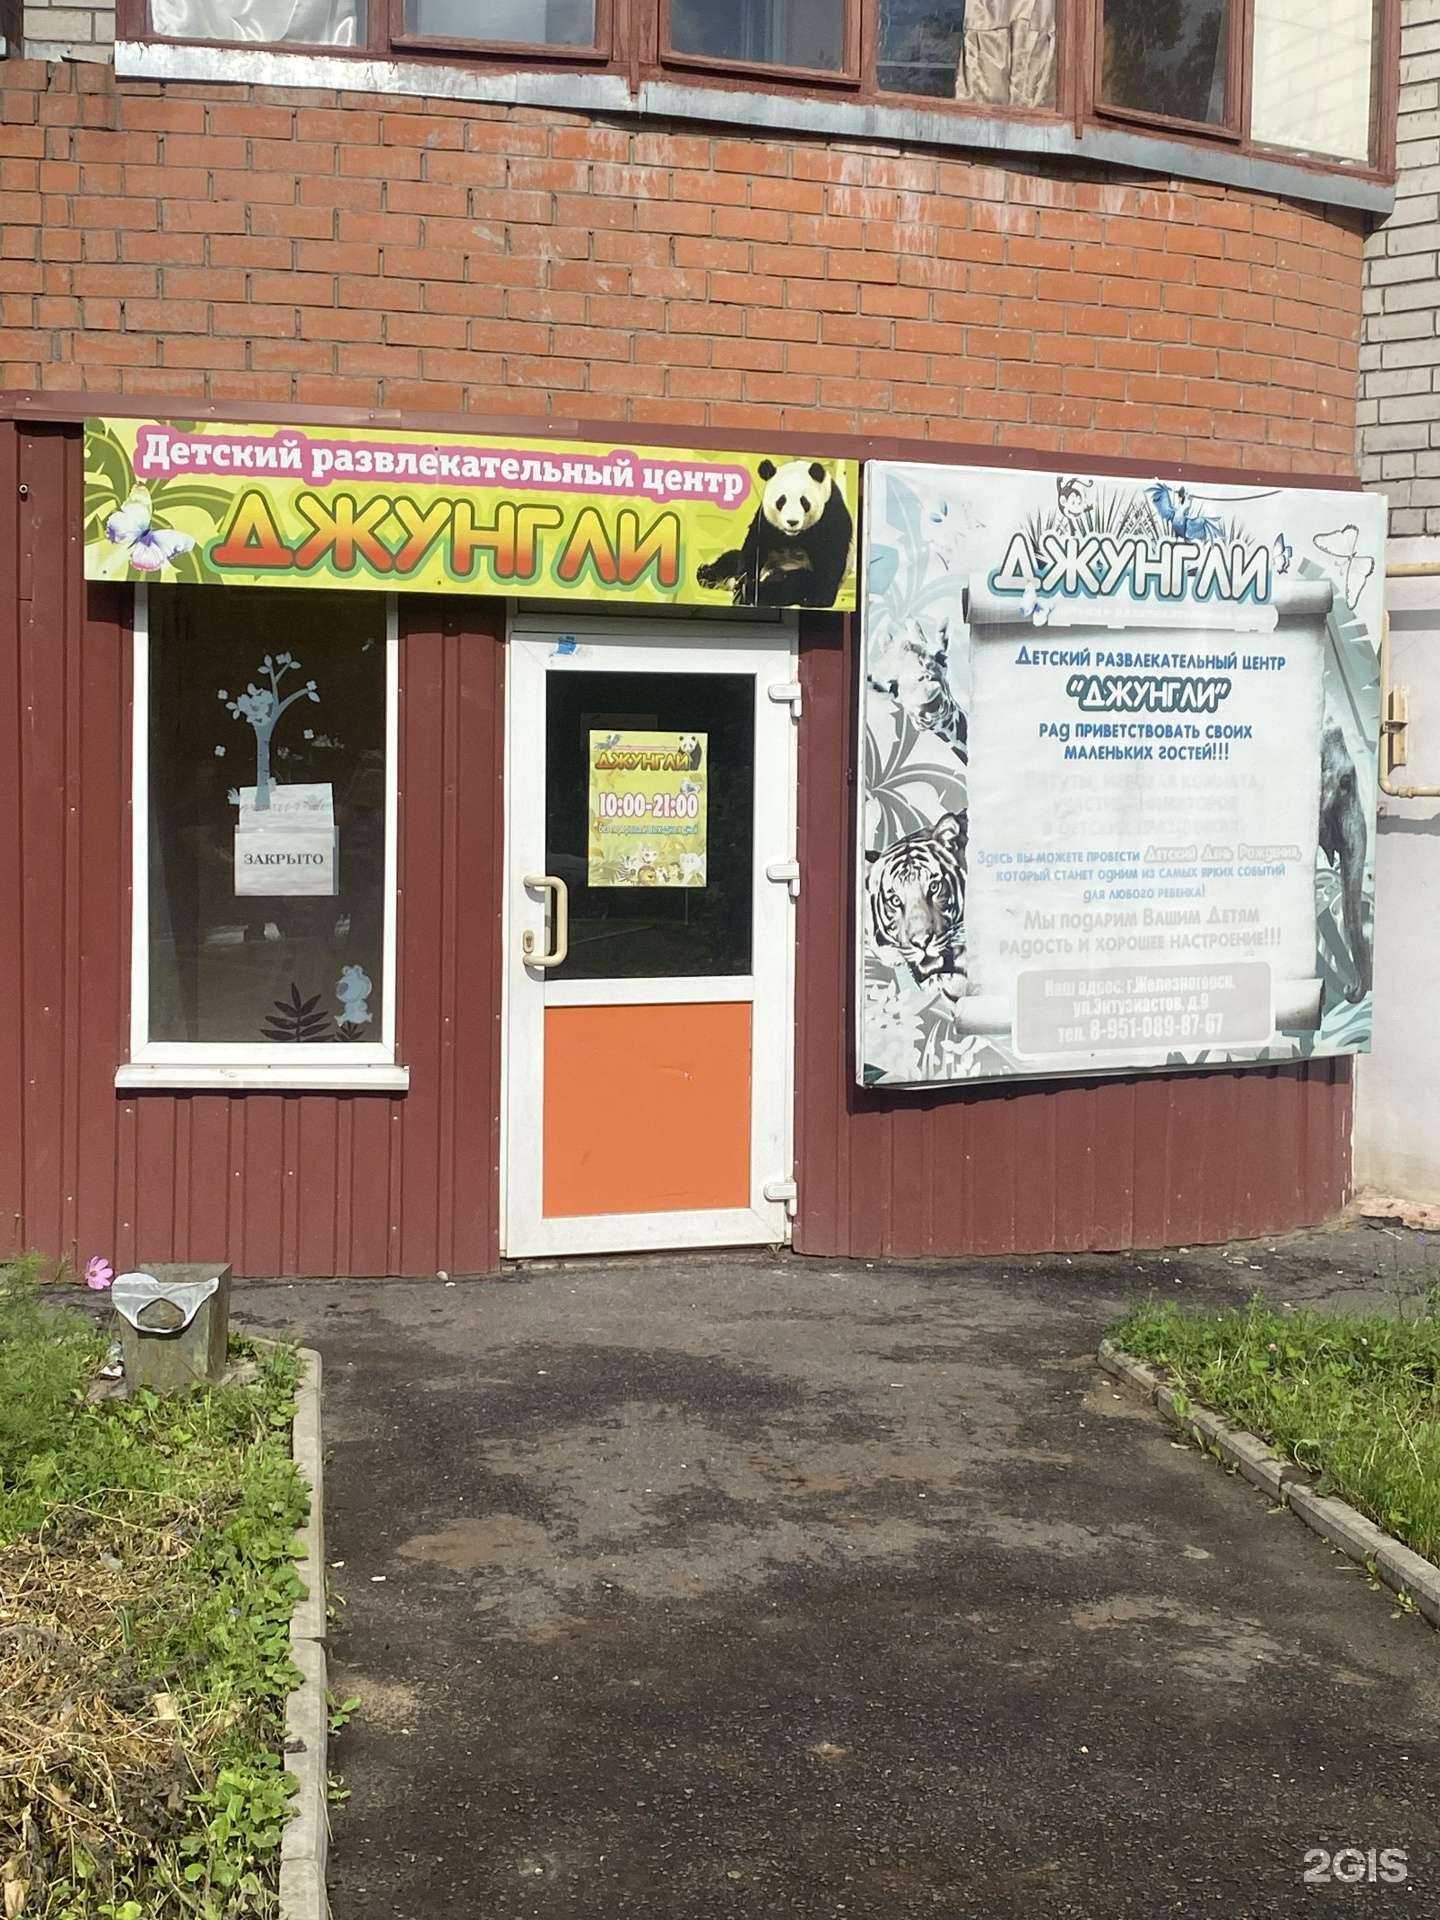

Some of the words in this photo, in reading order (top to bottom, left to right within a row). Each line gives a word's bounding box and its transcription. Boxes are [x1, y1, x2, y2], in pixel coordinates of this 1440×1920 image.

[143, 432, 303, 474] Детский
[312, 446, 634, 490] развлекательный
[641, 463, 744, 497] центр
[212, 489, 681, 586] ДЖУНГЛИ
[992, 532, 1271, 600] ДЖУНГЛИ
[595, 750, 690, 771] ДЖУНГЛИ
[599, 792, 698, 818] 10:00-21:00
[243, 852, 325, 866] ЗАКРЫТО
[1045, 979, 1076, 997] Наш
